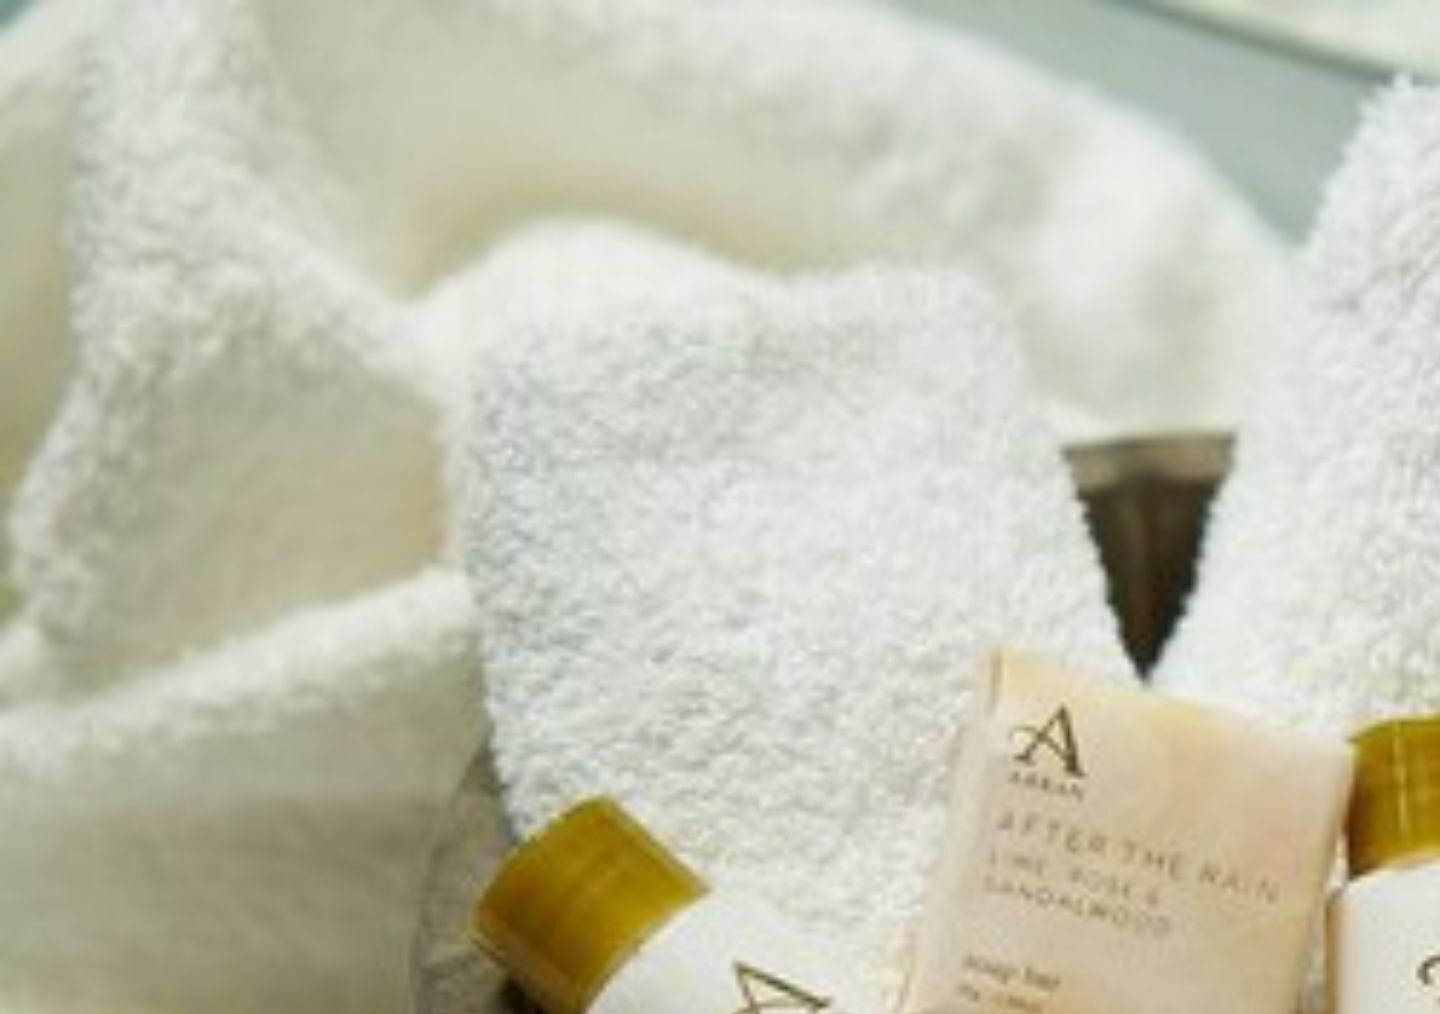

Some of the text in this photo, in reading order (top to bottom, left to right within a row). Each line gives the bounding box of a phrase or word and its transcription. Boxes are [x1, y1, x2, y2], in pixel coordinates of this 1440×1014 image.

[995, 809, 1281, 905] AFTER THE RAIN
[983, 874, 1173, 938] SANDALWOOD
